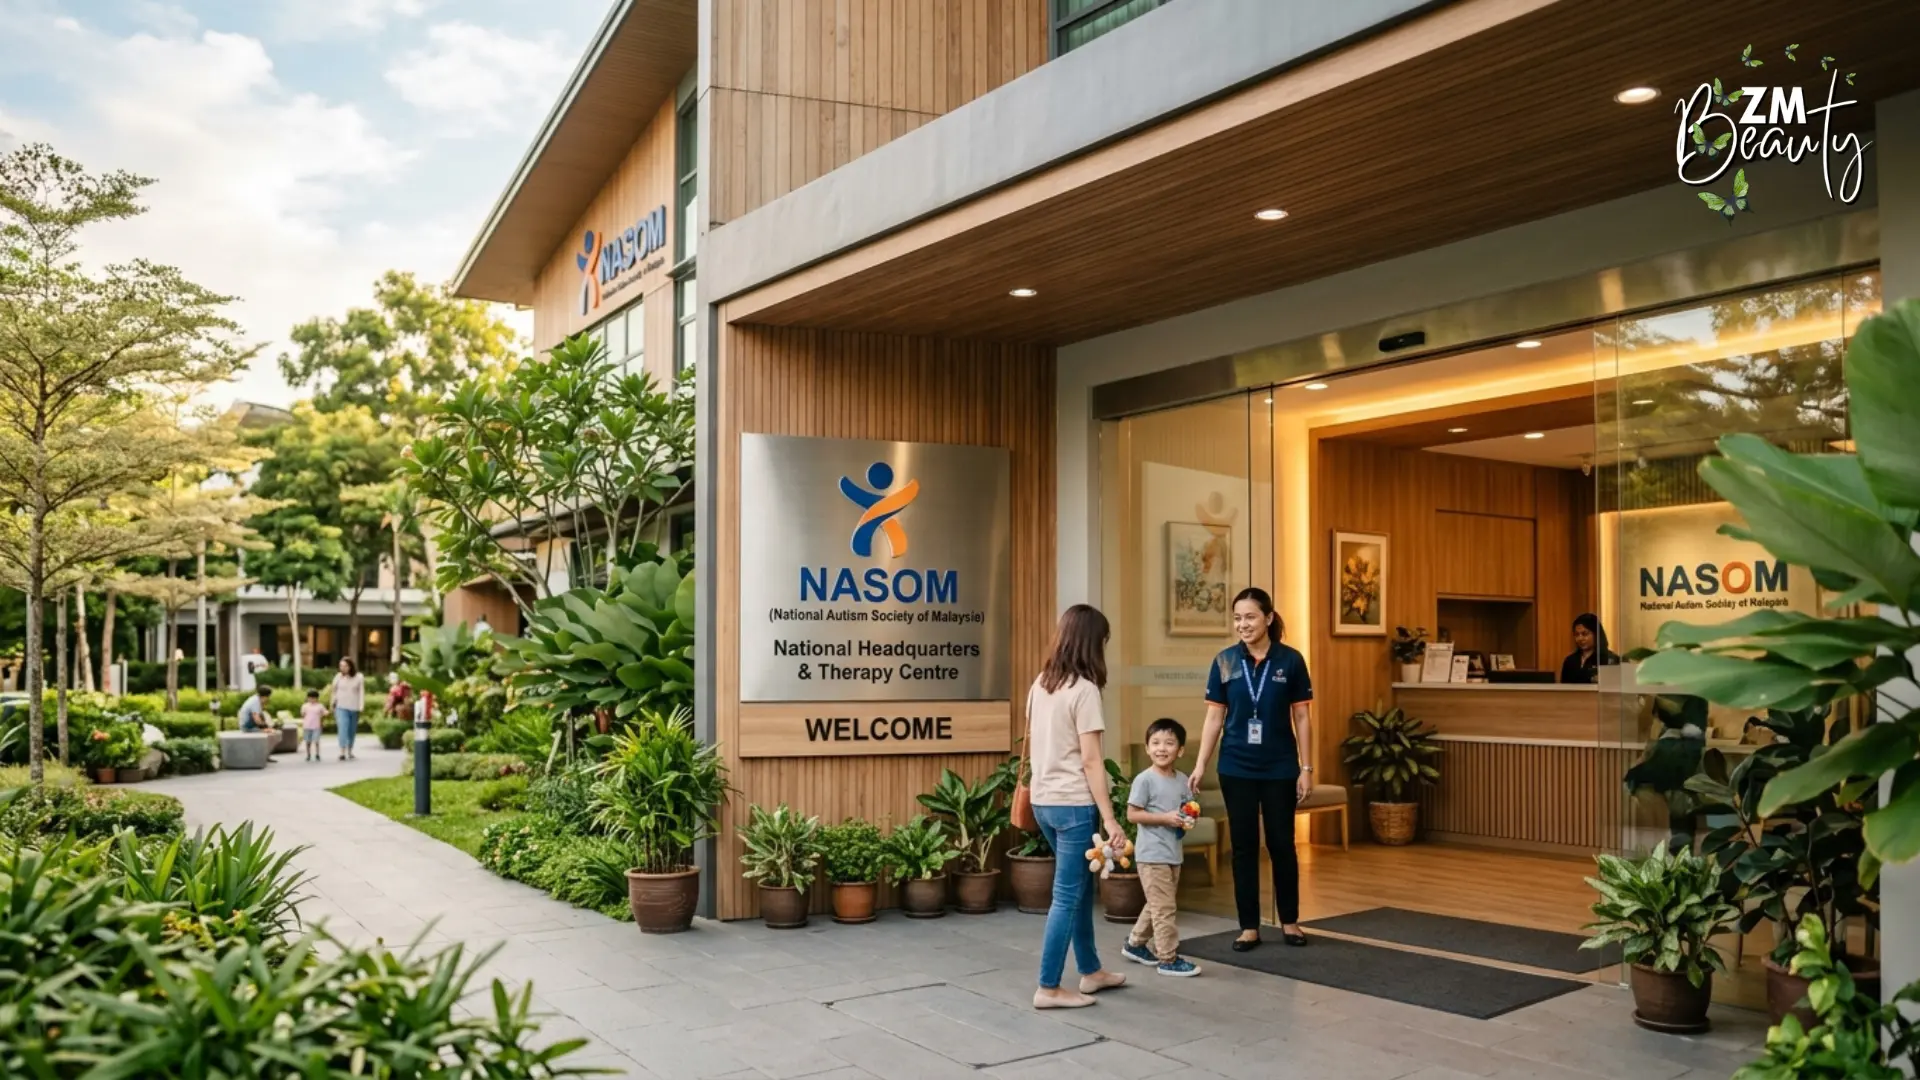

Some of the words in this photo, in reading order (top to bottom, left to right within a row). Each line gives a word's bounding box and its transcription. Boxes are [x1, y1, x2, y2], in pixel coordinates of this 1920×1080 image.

[600, 204, 666, 286] NASOM
[800, 566, 958, 603] NASOM
[1640, 560, 1788, 597] NASOM
[769, 608, 823, 623] (National
[826, 609, 868, 621] Autism
[871, 609, 914, 625] Society
[917, 610, 929, 622] of
[774, 639, 852, 656] National
[858, 640, 980, 660] Headquarters
[797, 663, 812, 680] &
[818, 663, 893, 684] Therapy
[899, 664, 959, 680] Centre
[805, 717, 953, 741] WELCOME
